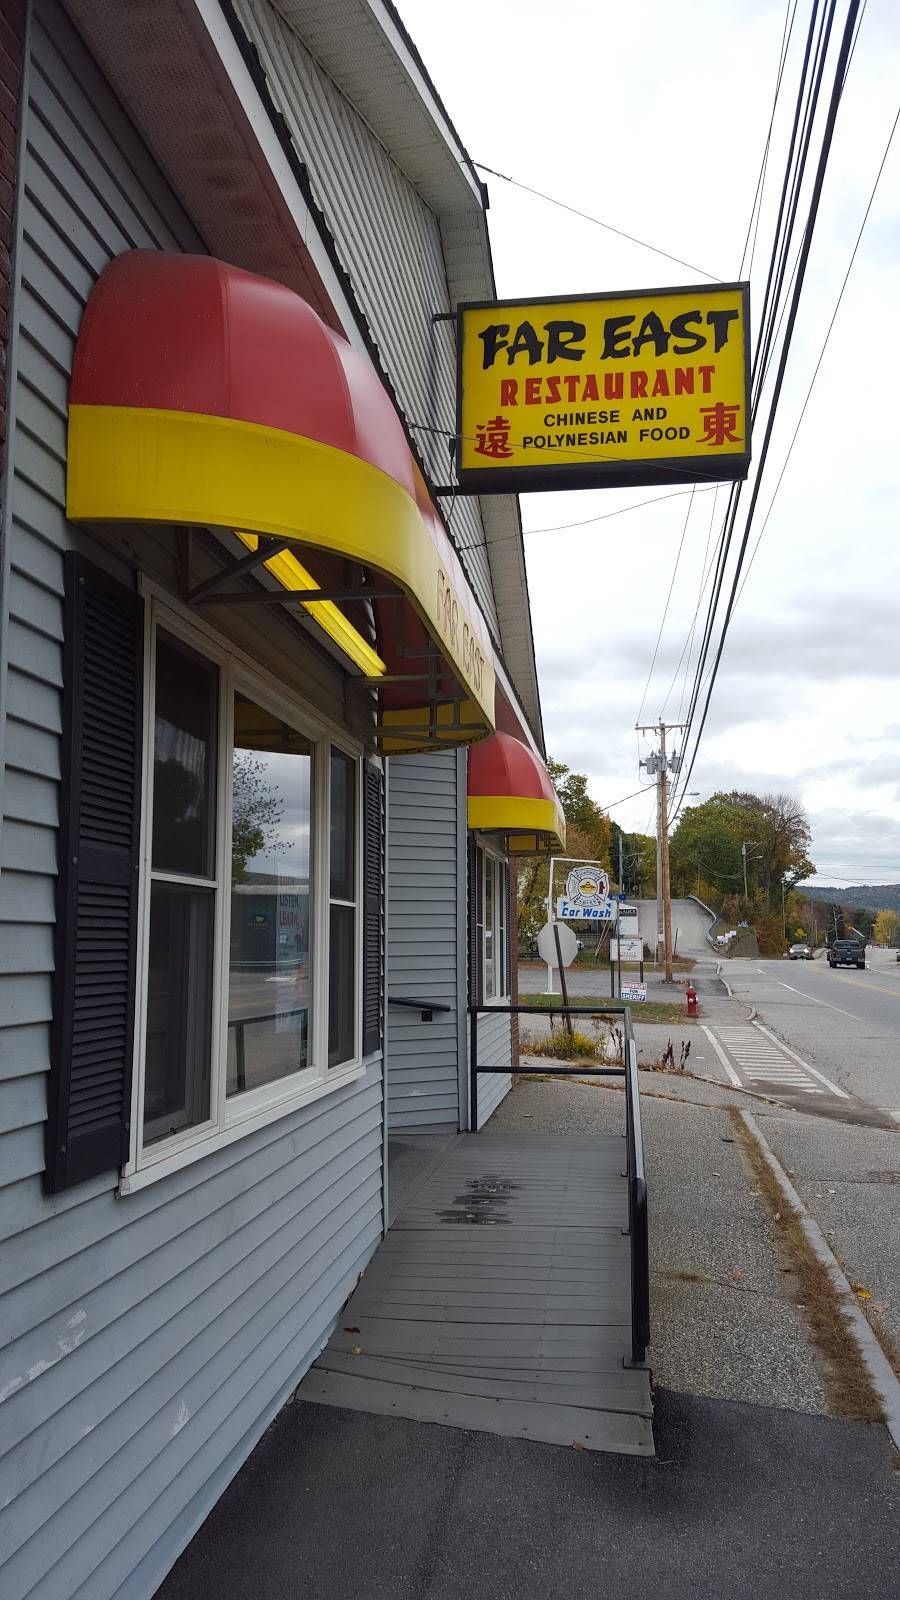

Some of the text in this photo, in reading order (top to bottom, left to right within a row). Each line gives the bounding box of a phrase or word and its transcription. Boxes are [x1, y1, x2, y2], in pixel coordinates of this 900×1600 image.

[478, 309, 739, 370] FAR EAST
[500, 365, 716, 407] RESTAURANT
[473, 416, 514, 459] 遠
[522, 426, 690, 449] POLYNESIAN FOOD
[543, 407, 668, 427] CHINESE AND
[695, 402, 744, 447] 東
[436, 568, 485, 698] FAR EAST
[561, 907, 581, 917] Car
[583, 907, 612, 918] Wash
[622, 993, 645, 1001] SHERIFF
